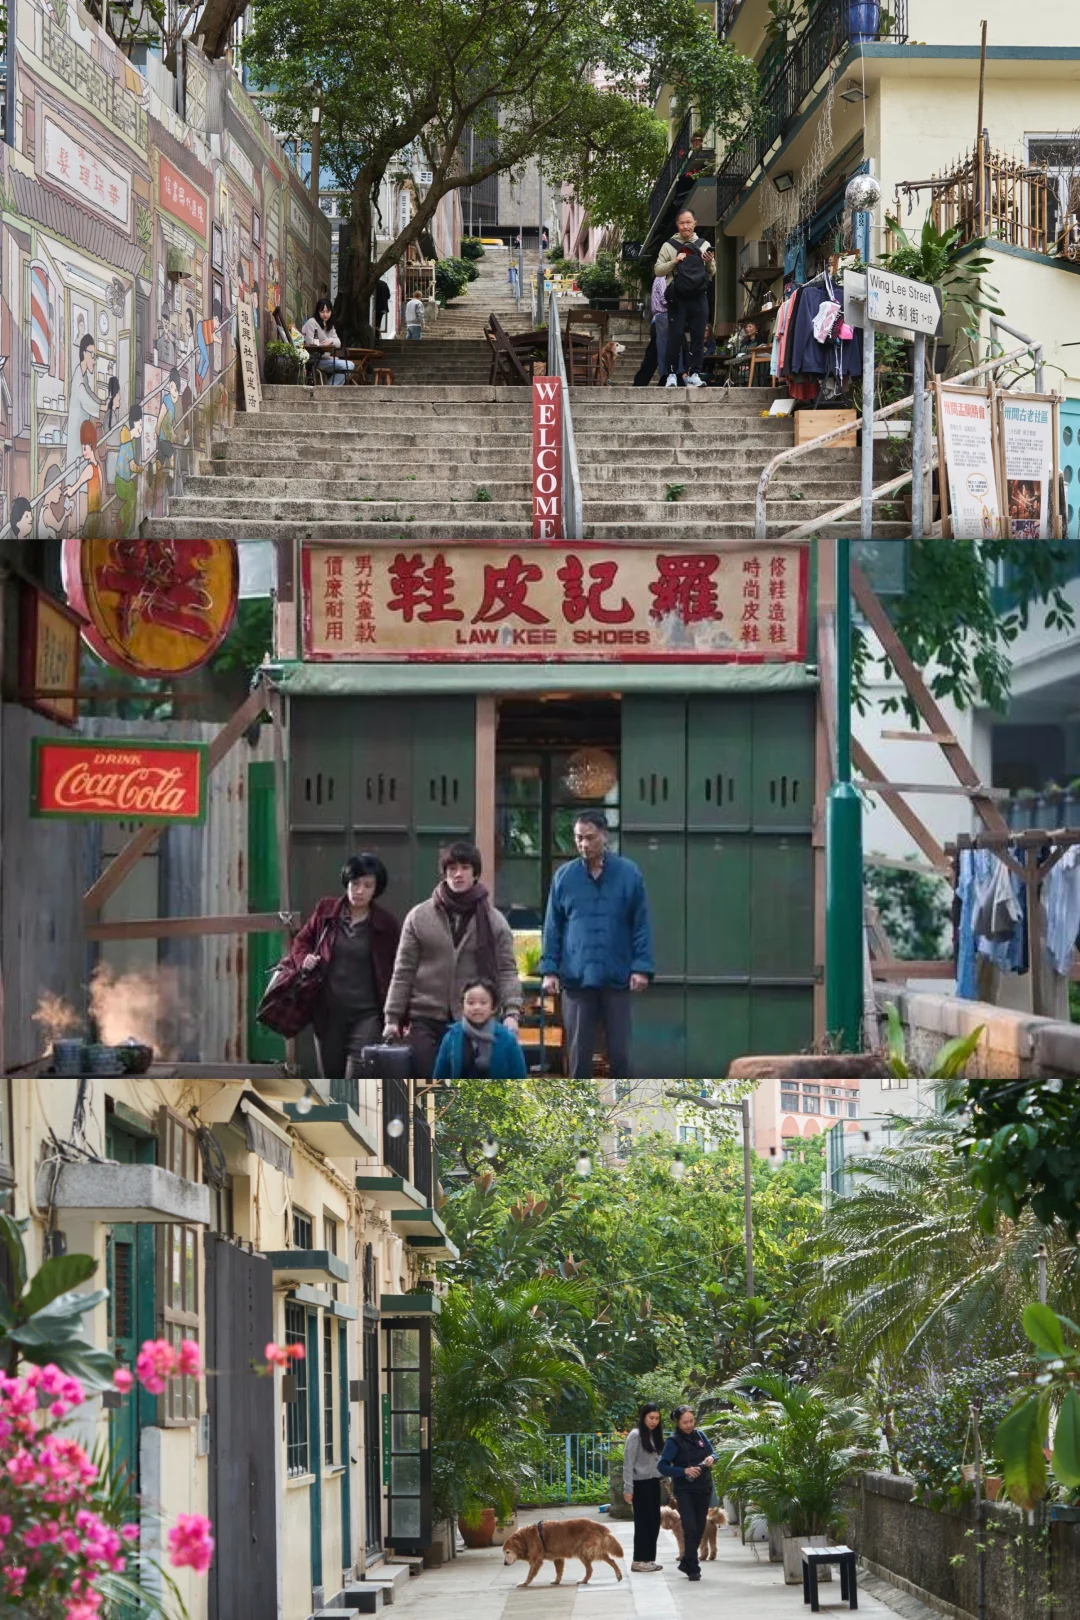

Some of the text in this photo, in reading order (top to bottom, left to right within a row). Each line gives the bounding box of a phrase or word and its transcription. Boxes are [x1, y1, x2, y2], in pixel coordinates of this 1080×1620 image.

[869, 274, 931, 303] Wing Lee Street
[886, 301, 919, 324] 永利街
[535, 382, 559, 539] WELCOME
[456, 629, 651, 645] LAW KEE SHOES
[93, 753, 143, 765] DRINK
